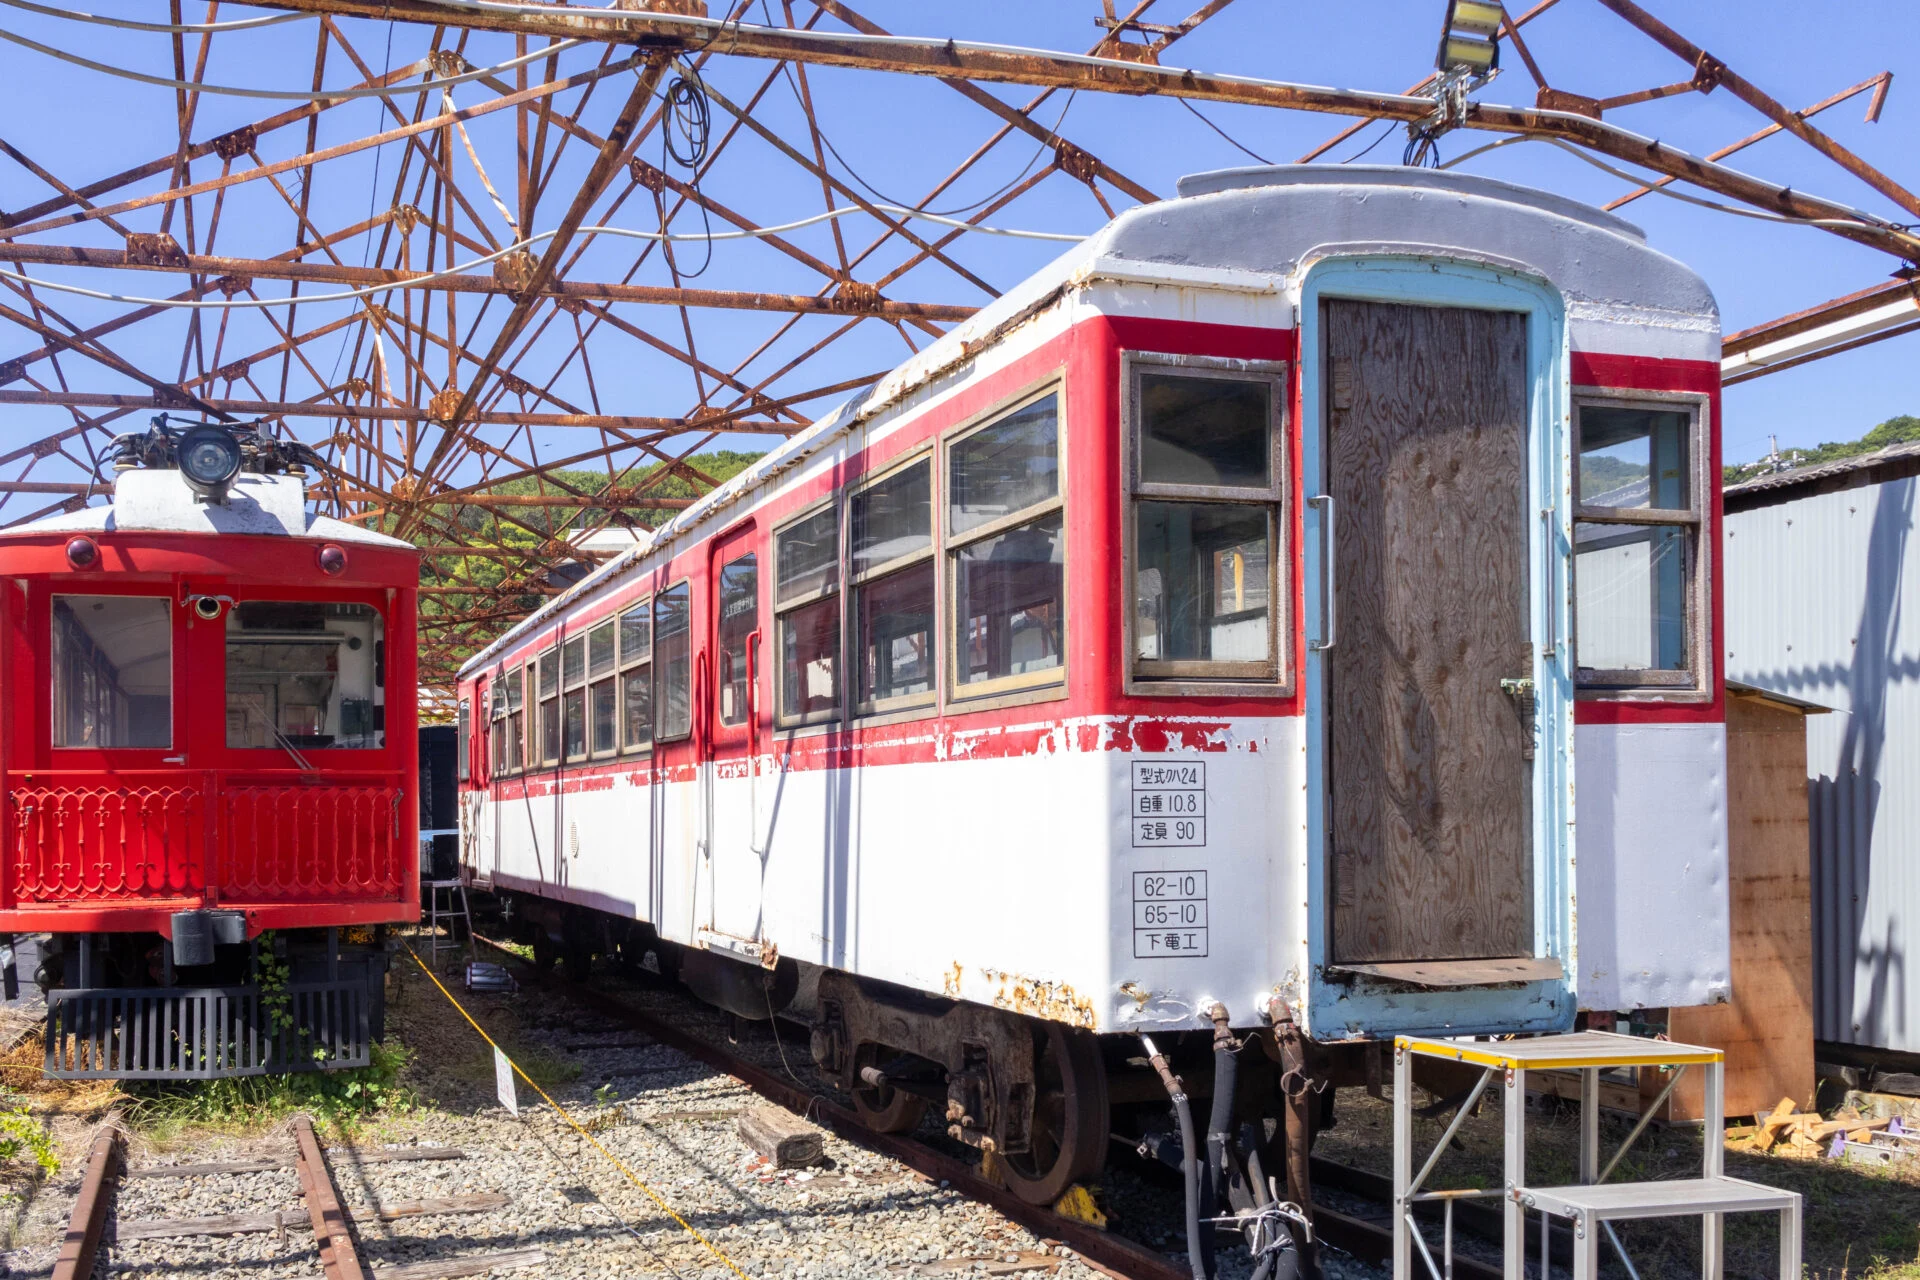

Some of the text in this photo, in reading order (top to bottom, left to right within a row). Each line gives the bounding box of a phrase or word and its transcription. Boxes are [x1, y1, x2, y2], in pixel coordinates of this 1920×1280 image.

[1140, 794, 1196, 812] 自重 10.8
[1140, 821, 1195, 840] 定員 90
[1144, 876, 1195, 896] 62-10
[1145, 904, 1196, 923] 65-10
[1145, 933, 1198, 950] 下電工
